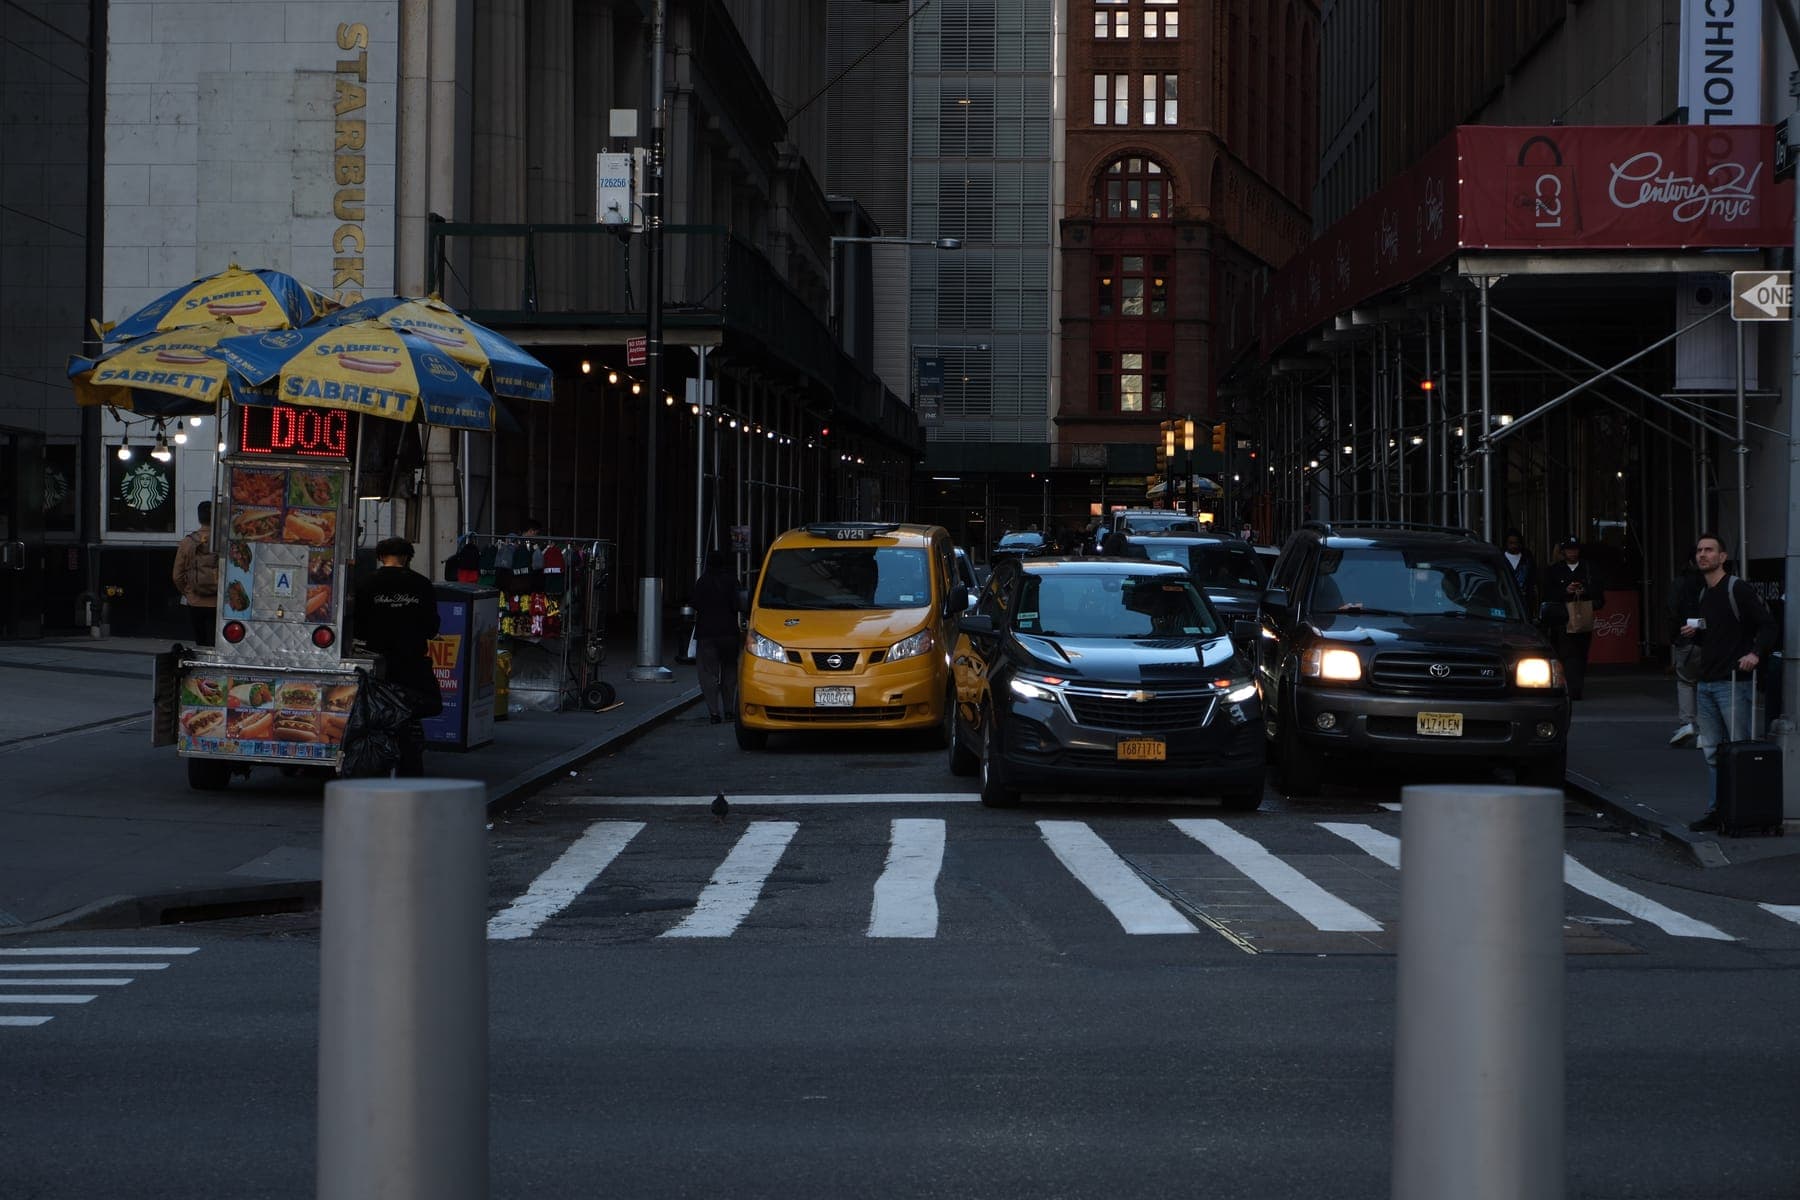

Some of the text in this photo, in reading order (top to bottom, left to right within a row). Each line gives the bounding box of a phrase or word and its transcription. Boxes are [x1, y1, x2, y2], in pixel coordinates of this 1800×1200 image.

[1609, 152, 1763, 223] Century 21
[1535, 174, 1561, 228] C21
[1711, 200, 1751, 222] nyc
[185, 289, 262, 310] SABRETT
[390, 317, 465, 334] SABRETT
[315, 343, 401, 356] SABRETT
[97, 369, 218, 394] SABRETT
[284, 376, 412, 413] SABRETT
[272, 405, 347, 449] DOG
[837, 529, 864, 540] 6V29
[277, 574, 289, 588] A
[438, 680, 458, 689] OWN
